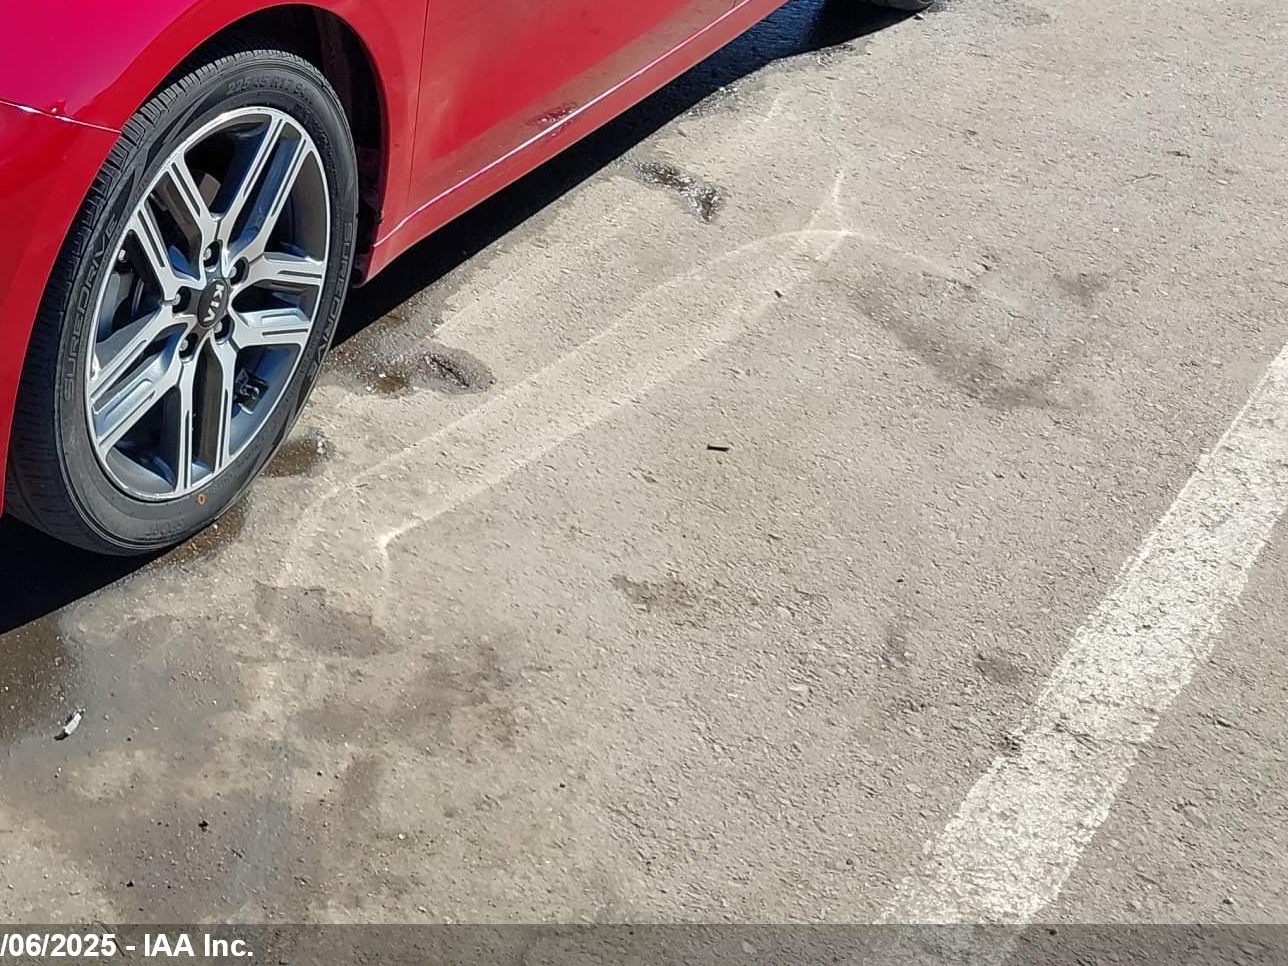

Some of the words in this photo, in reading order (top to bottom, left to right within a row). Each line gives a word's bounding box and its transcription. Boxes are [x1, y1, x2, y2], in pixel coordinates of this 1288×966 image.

[63, 214, 117, 402] SUREDRIVE
[203, 284, 224, 323] KIA
[308, 222, 353, 380] SUREDRIVE
